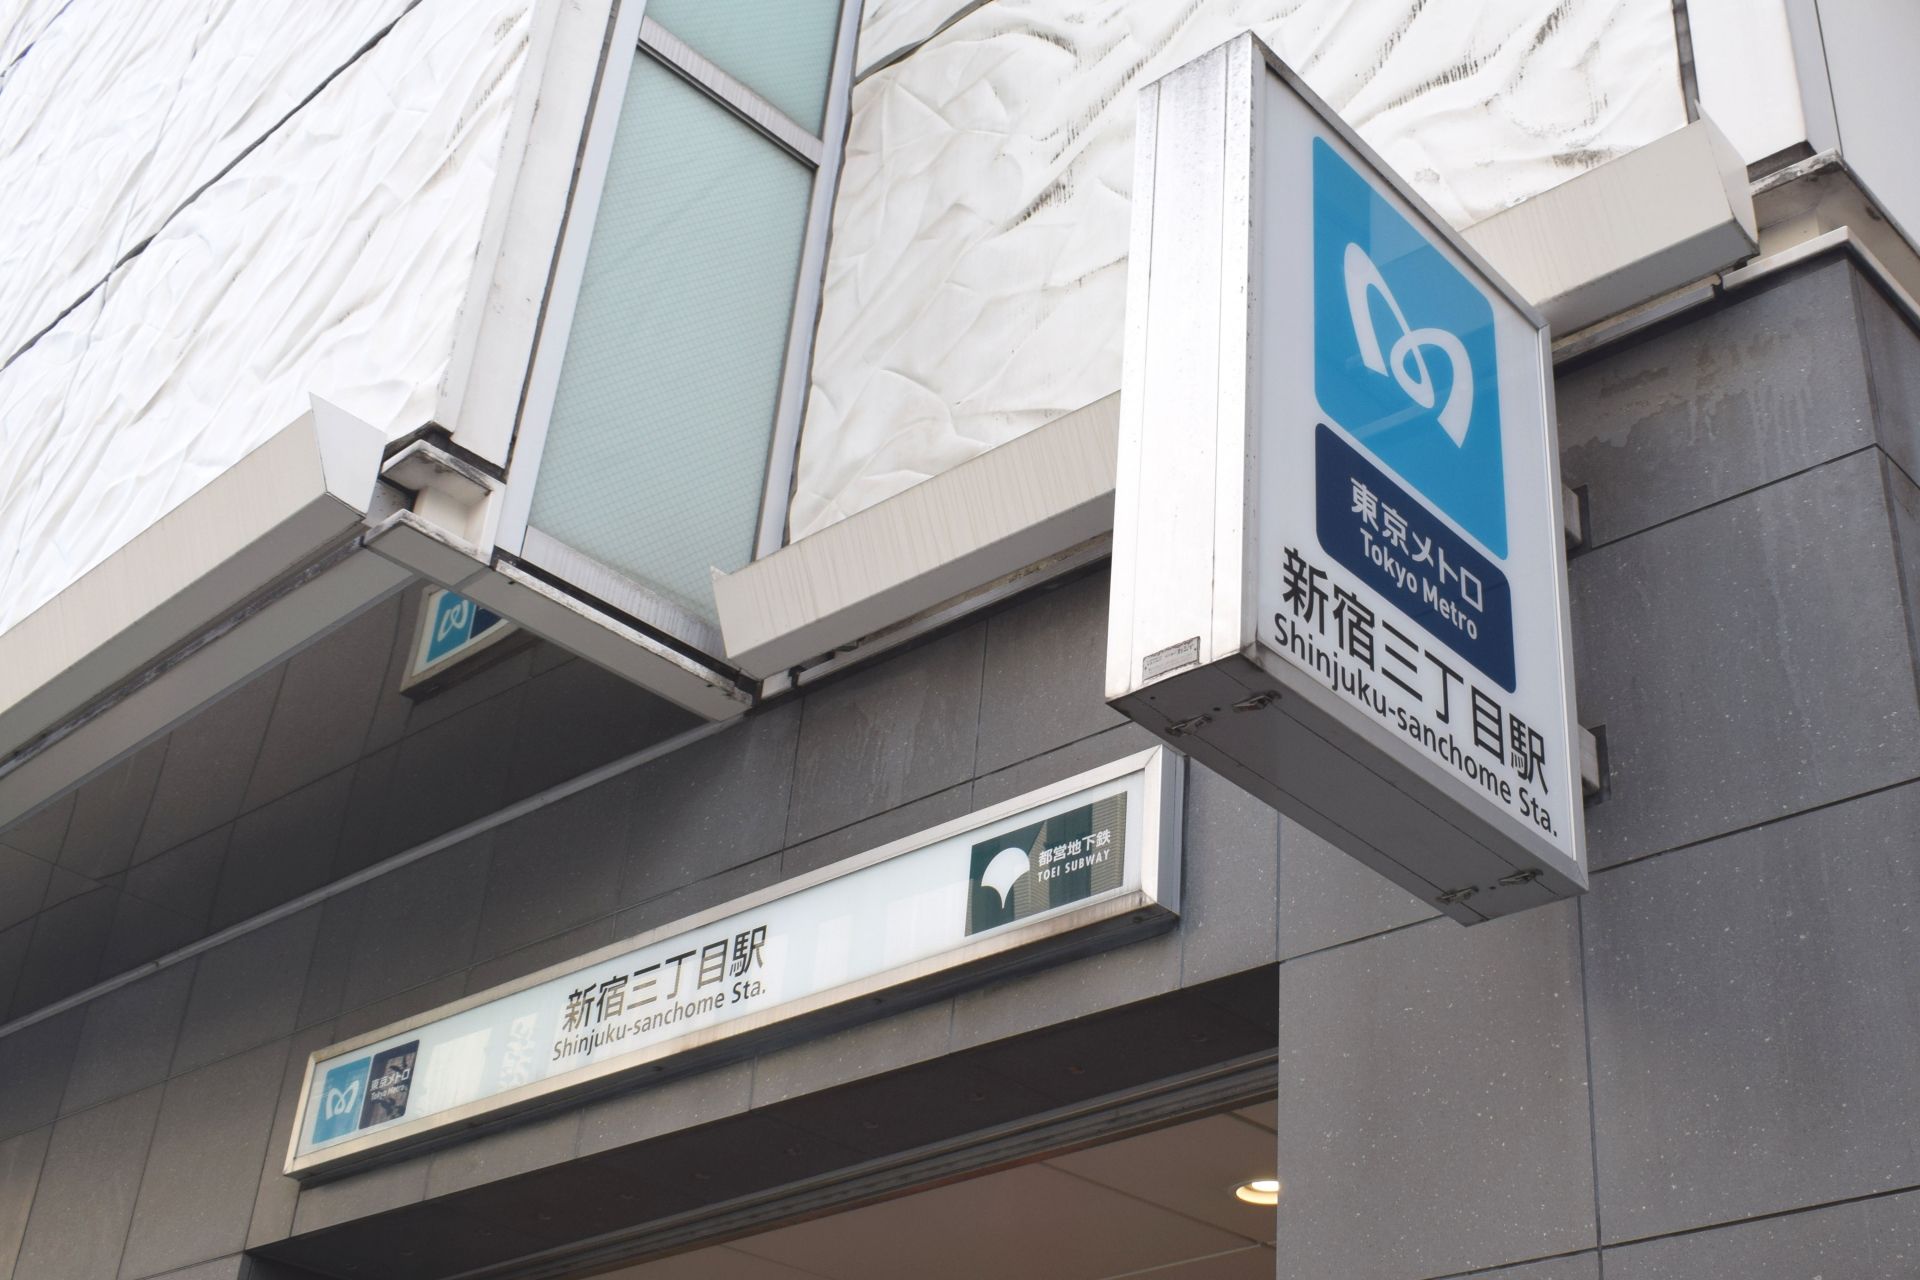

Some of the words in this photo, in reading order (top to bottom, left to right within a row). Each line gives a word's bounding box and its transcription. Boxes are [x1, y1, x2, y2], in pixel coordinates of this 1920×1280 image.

[1351, 477, 1483, 613] 東京メトロ
[1360, 527, 1418, 593] Tokyo
[1422, 577, 1478, 640] Metro
[1274, 612, 1511, 803] Shinjuku-sanchome
[1519, 787, 1558, 837] Sta.
[1282, 546, 1548, 794] 新宿三丁目駅
[1038, 865, 1060, 882] TOEI
[1065, 849, 1110, 874] SUBWAY
[1039, 829, 1111, 867] 都営地下鉄
[552, 991, 725, 1061] Shinjuku-sanchome
[731, 979, 766, 1004] Sta.
[562, 925, 767, 1032] 新宿三丁目駅
